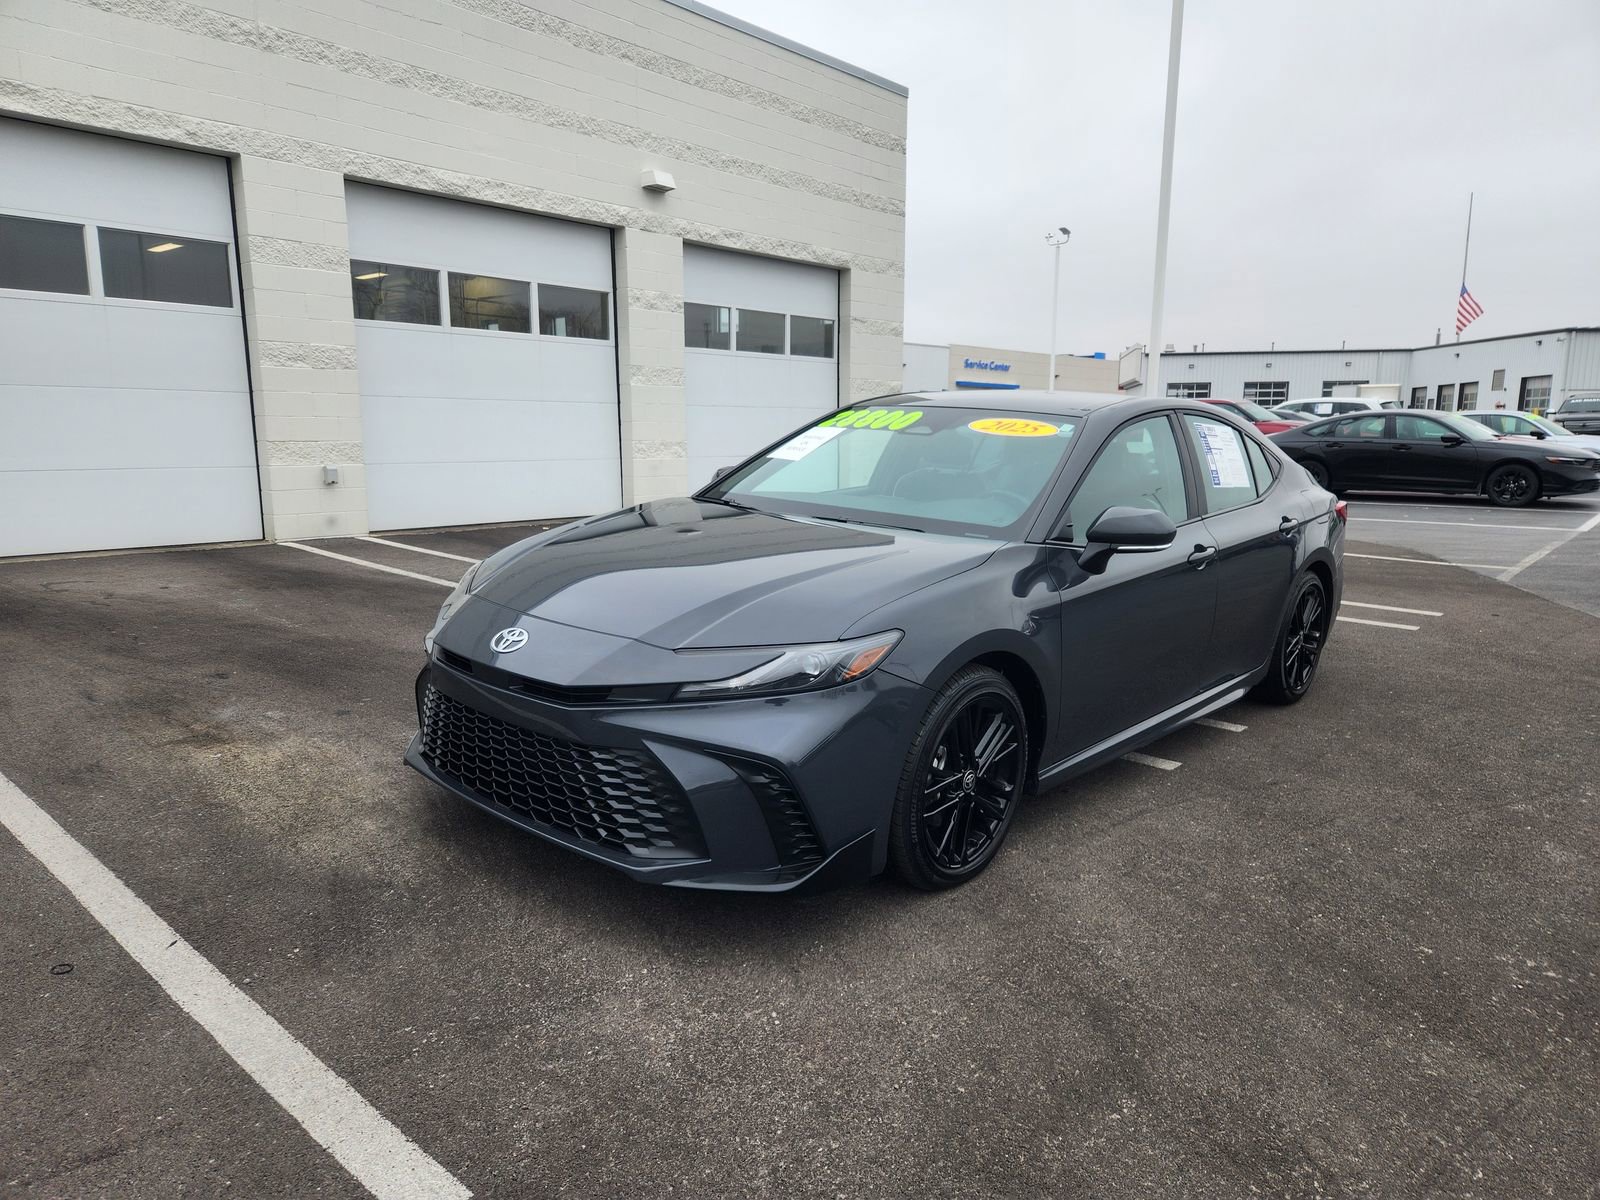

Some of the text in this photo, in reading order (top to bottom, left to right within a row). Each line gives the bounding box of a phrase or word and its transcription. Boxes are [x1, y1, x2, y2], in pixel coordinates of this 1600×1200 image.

[964, 359, 1010, 371] Service Center
[980, 421, 1047, 433] 2025
